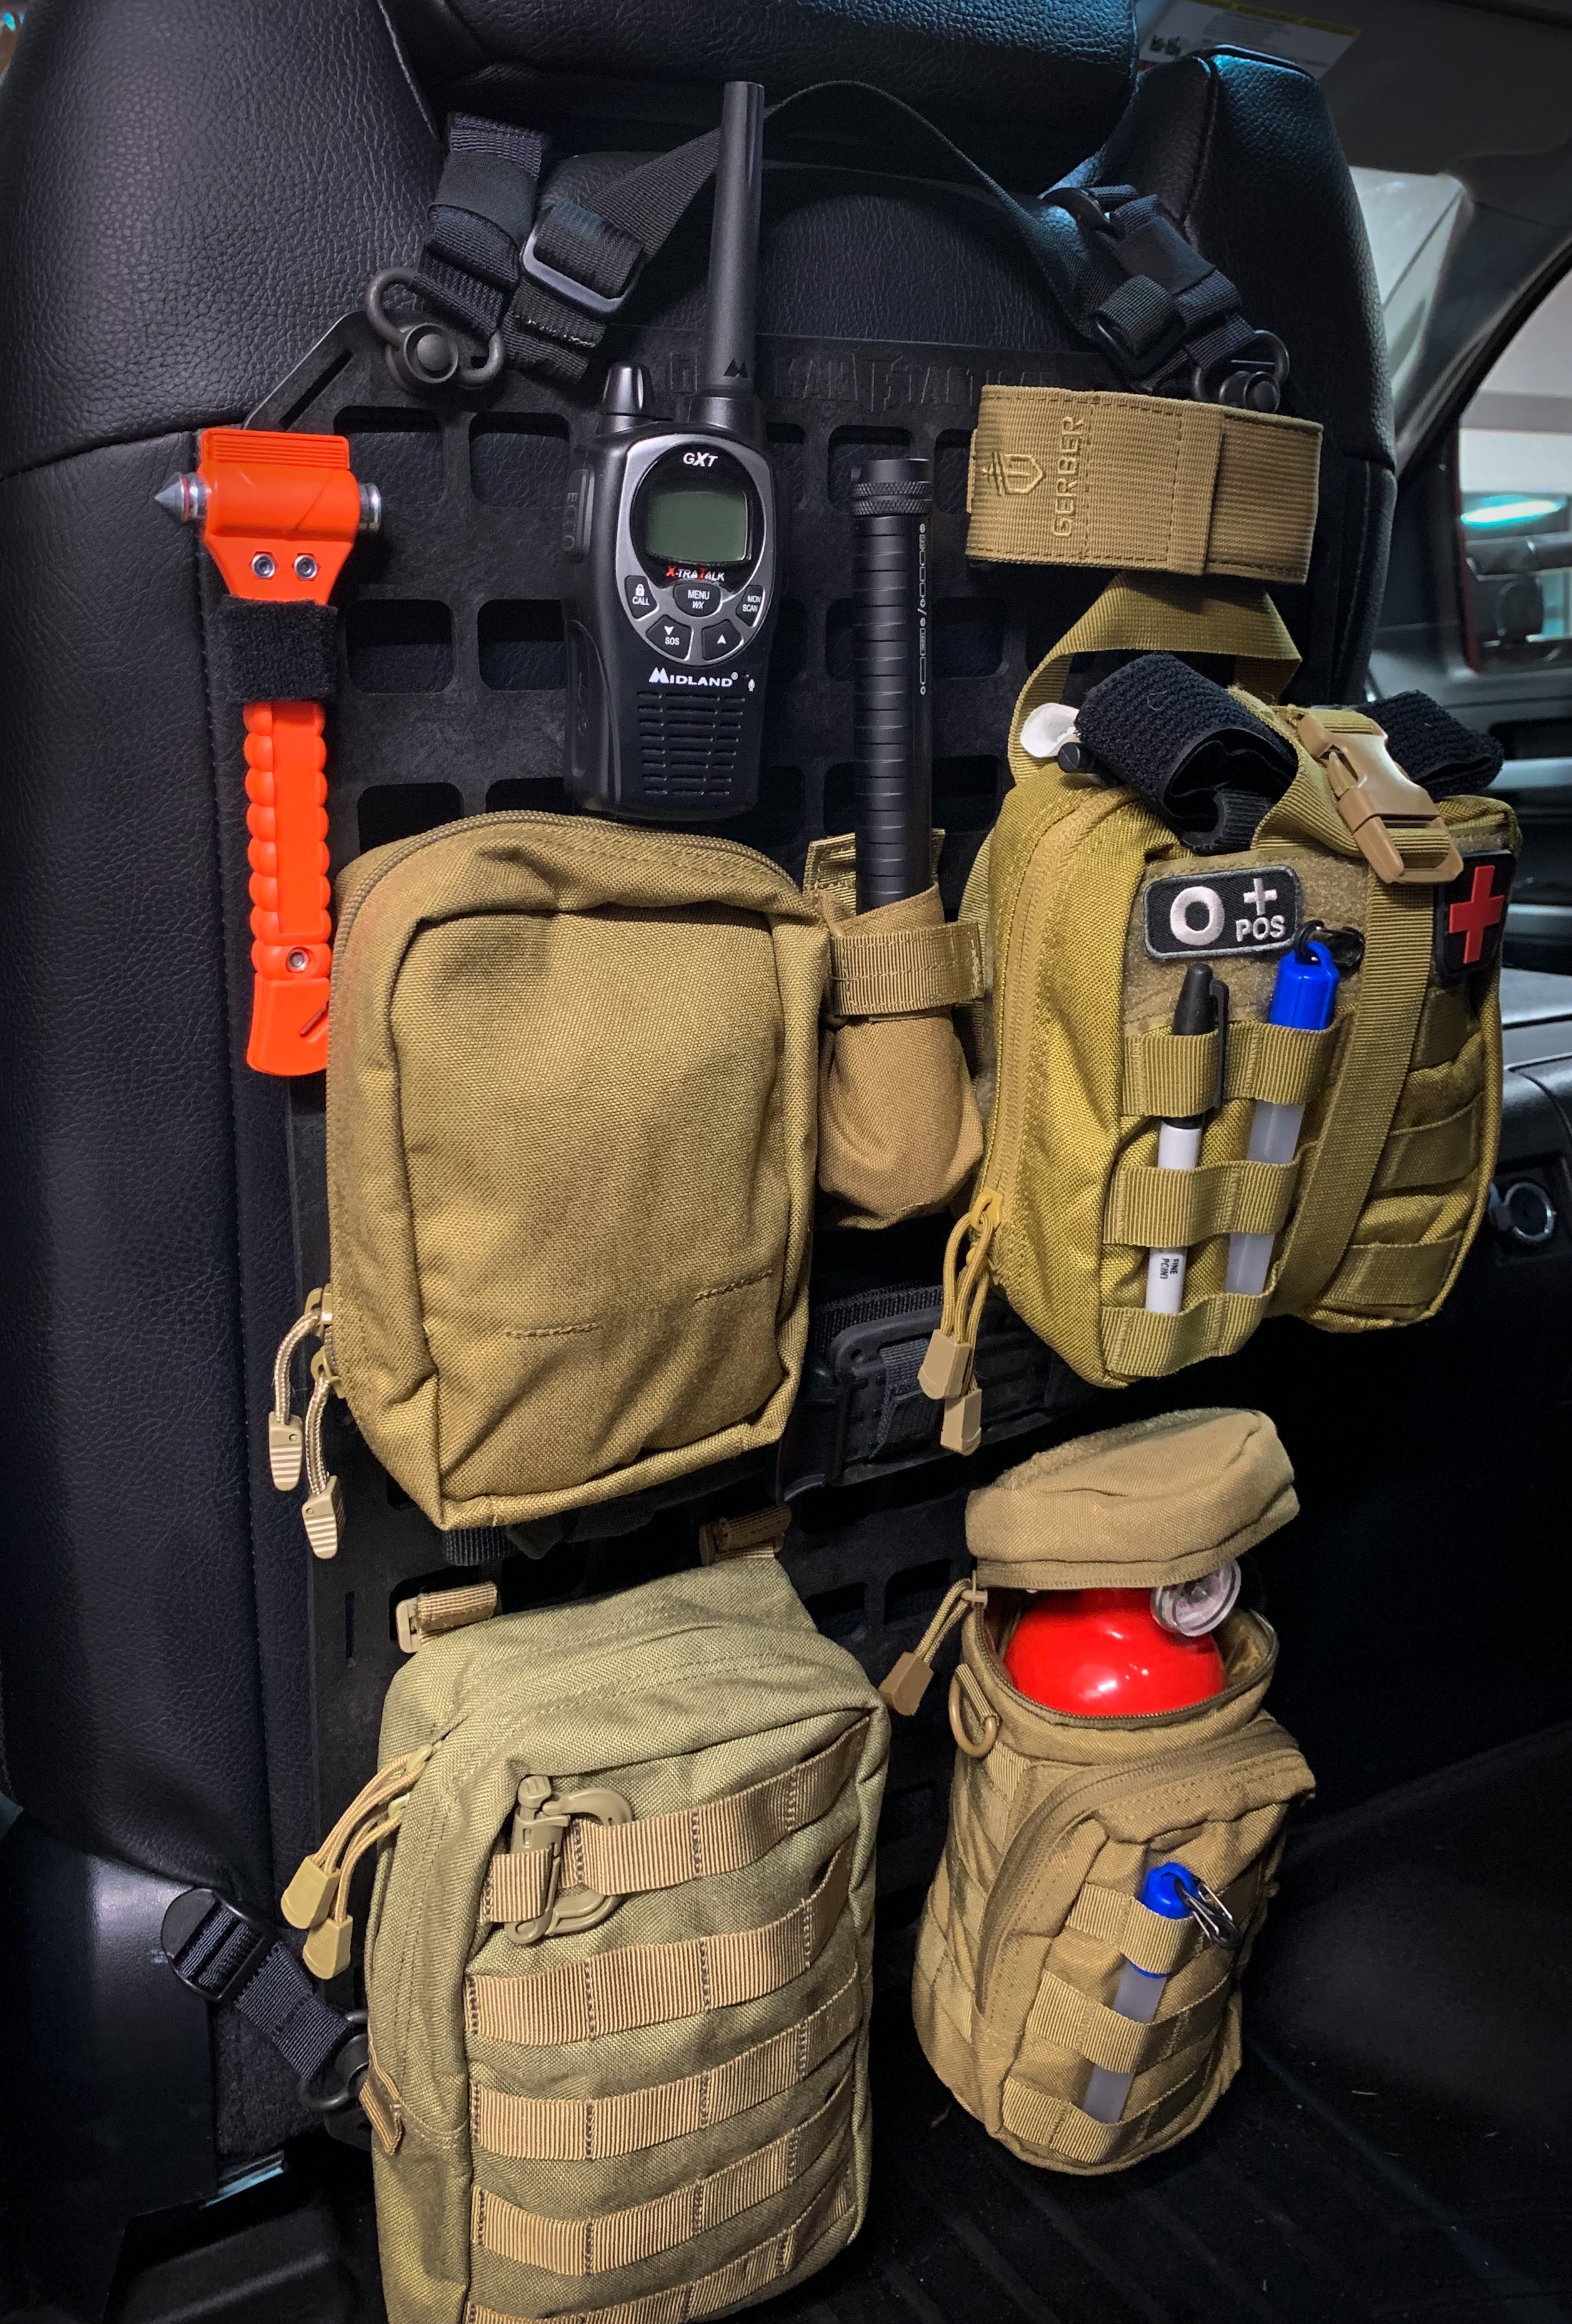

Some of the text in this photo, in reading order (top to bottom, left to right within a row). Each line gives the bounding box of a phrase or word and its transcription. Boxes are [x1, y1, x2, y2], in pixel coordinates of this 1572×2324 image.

[683, 452, 719, 467] GXT
[1053, 416, 1085, 537] GERBER
[632, 596, 650, 606] CALL
[688, 590, 710, 600] MENU
[692, 601, 704, 610] WX
[742, 604, 758, 613] SCAN
[664, 637, 680, 646] SOS
[648, 667, 733, 687] MIDLAND
[1170, 886, 1225, 946] O
[1235, 915, 1285, 942] POS
[1159, 1257, 1170, 1279] POINT
[1169, 1258, 1179, 1274] FINE
